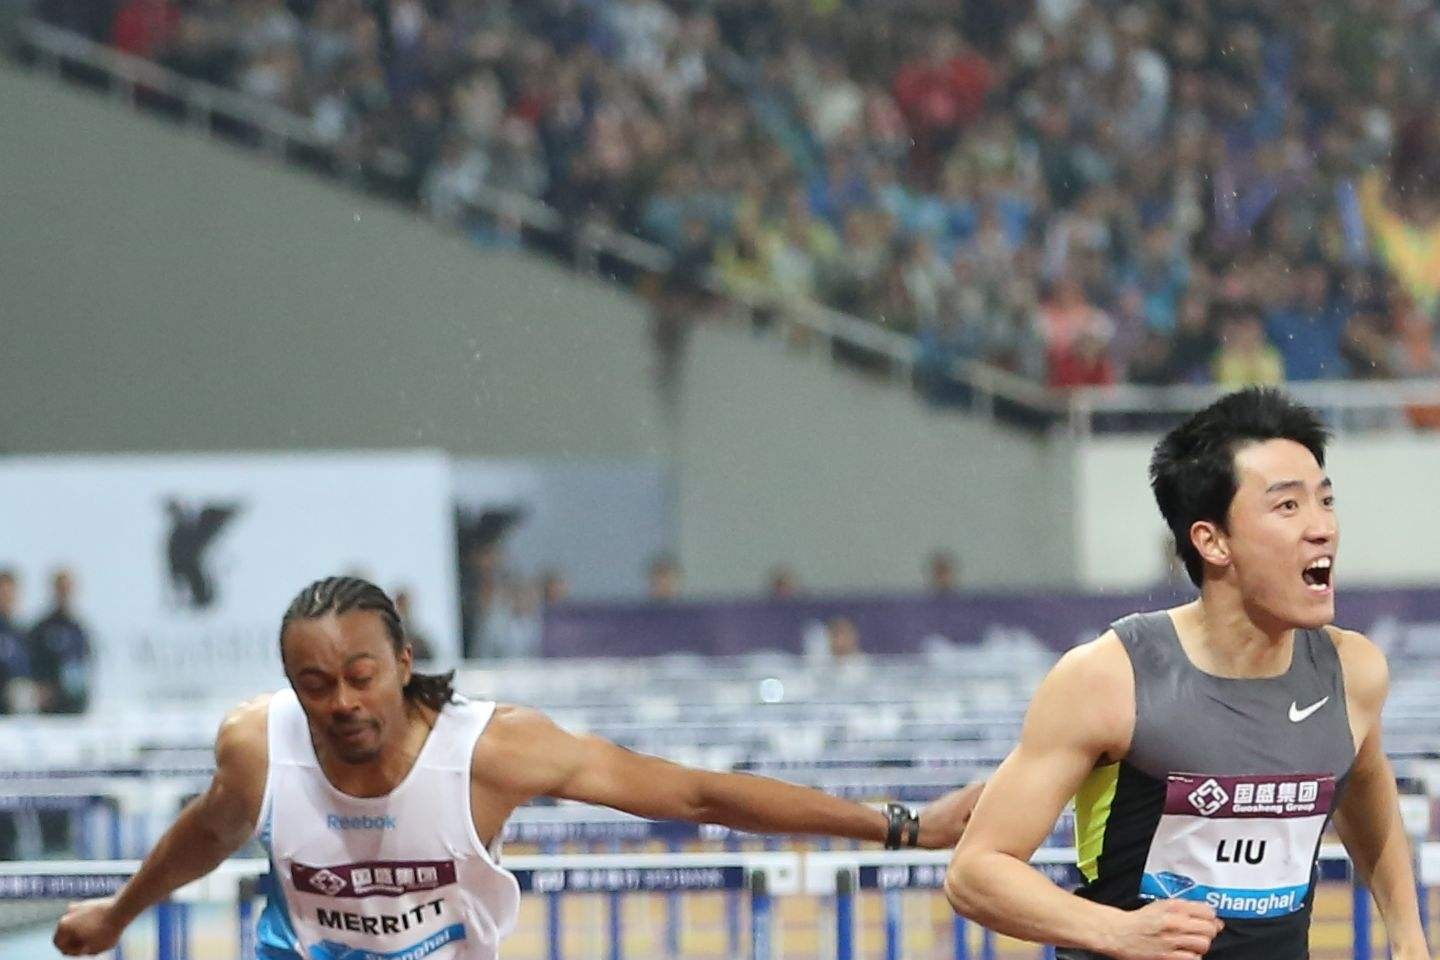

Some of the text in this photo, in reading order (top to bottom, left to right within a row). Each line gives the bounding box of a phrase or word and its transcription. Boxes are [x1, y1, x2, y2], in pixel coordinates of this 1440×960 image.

[1234, 781, 1318, 804] 国盛集团
[327, 814, 396, 830] Reebok
[1216, 839, 1267, 864] LIU
[1206, 890, 1295, 915] Shanghai
[316, 898, 445, 936] MERRITT
